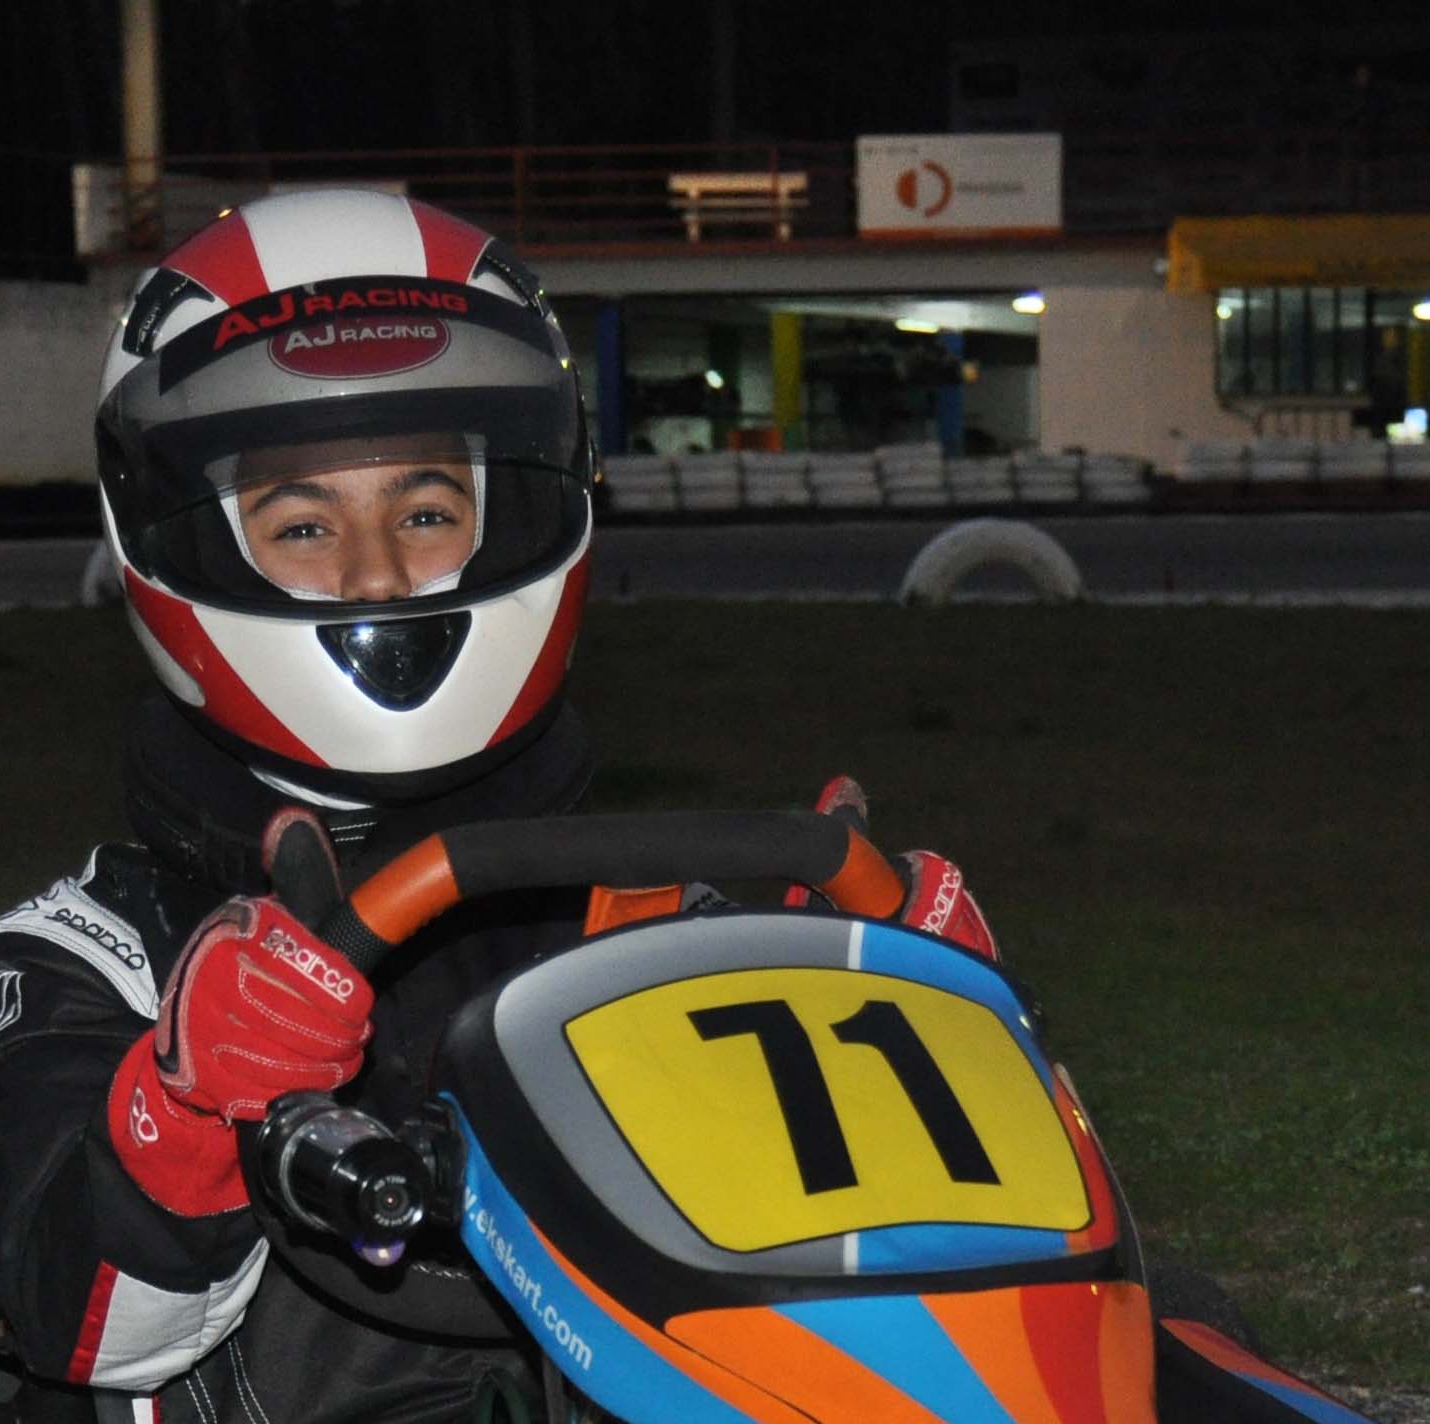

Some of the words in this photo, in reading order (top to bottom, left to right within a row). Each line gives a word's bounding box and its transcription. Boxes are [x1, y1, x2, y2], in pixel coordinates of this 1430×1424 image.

[213, 291, 296, 350] AJ
[303, 287, 469, 318] RACING
[283, 324, 336, 354] AJ
[340, 325, 438, 343] RACING
[44, 907, 146, 971] sparco
[260, 928, 355, 1004] sparco
[685, 998, 1002, 1197] 71
